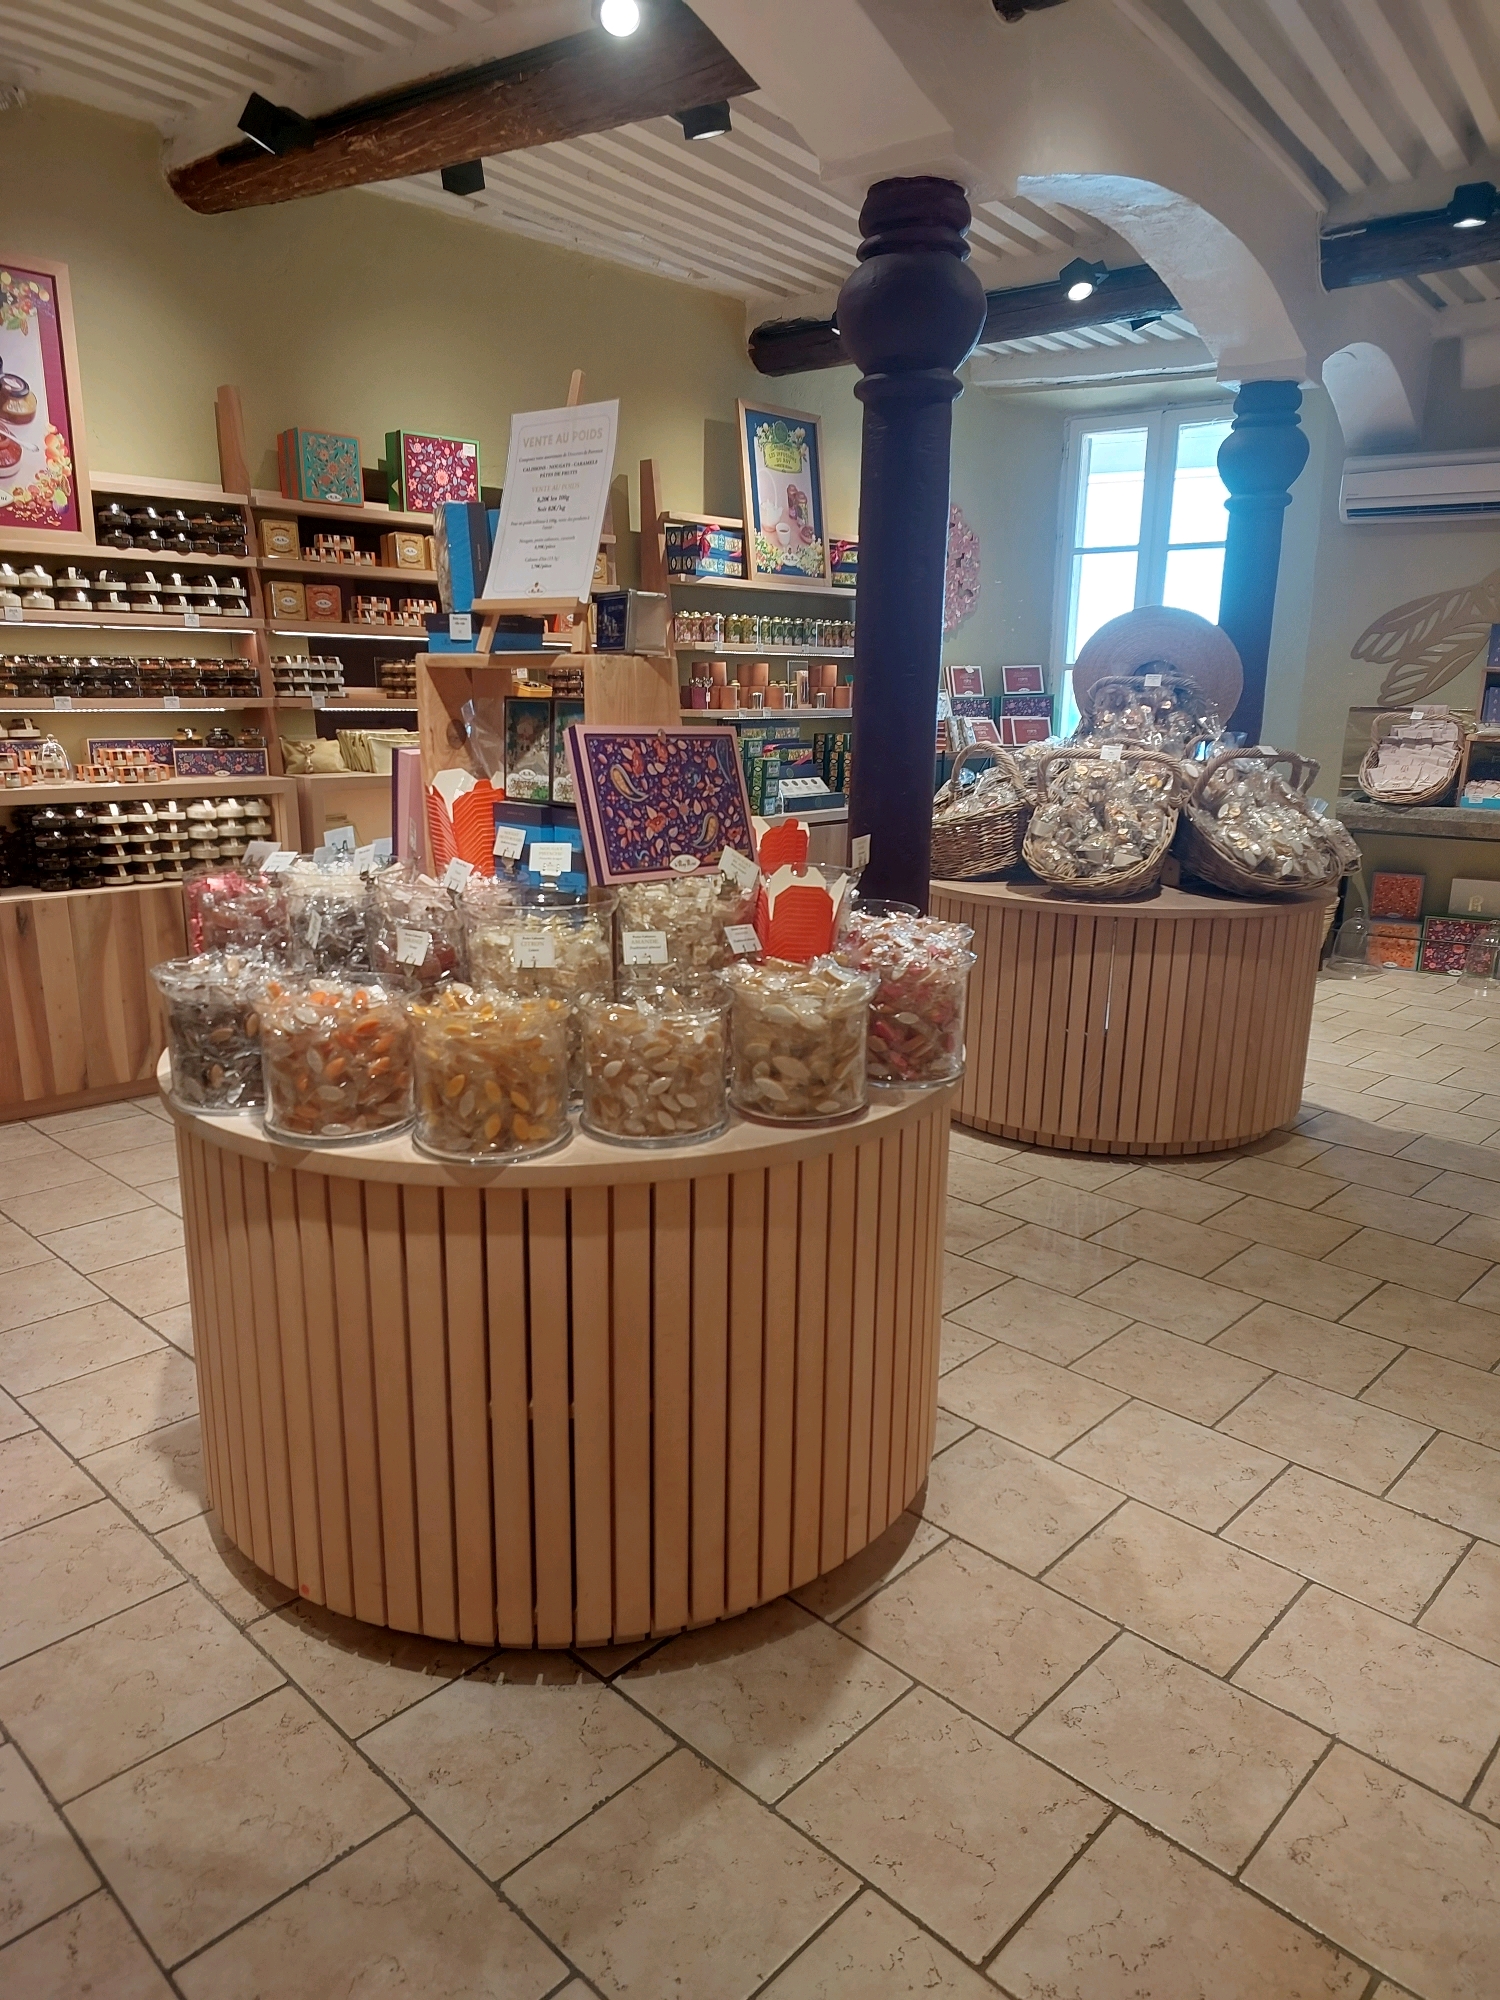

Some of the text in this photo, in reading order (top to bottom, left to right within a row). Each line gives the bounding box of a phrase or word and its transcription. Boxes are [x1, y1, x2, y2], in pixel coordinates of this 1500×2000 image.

[523, 428, 603, 448] VENTE AU POIDS
[561, 482, 580, 490] POIDS
